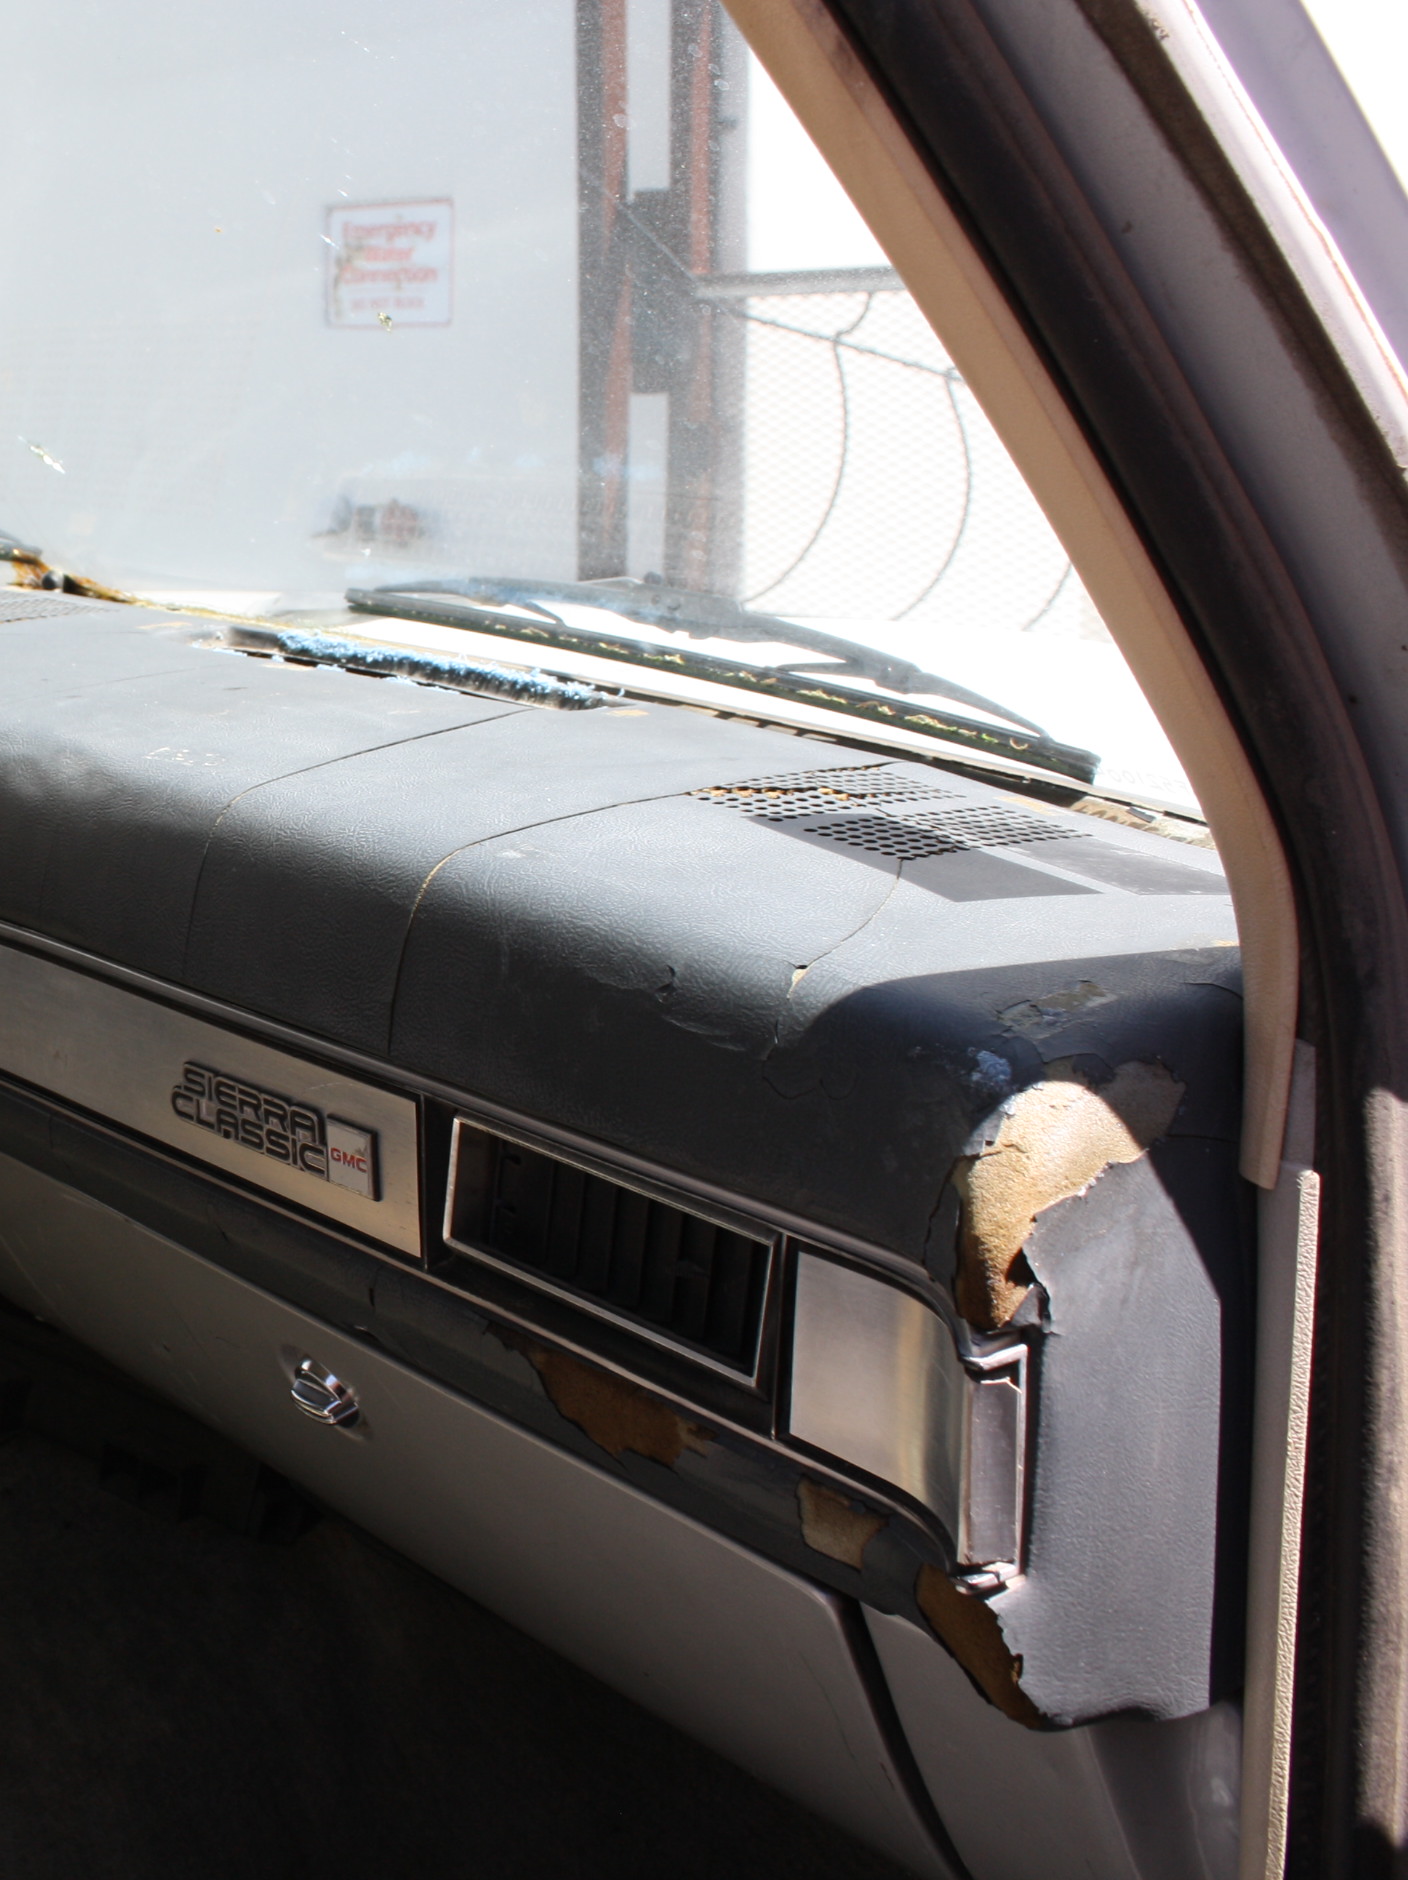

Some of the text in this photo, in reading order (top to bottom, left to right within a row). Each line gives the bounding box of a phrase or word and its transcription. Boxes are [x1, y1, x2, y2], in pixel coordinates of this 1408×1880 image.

[172, 1087, 326, 1175] CLASSIC
[184, 1064, 320, 1144] SIERRA
[330, 1147, 368, 1173] GMC
